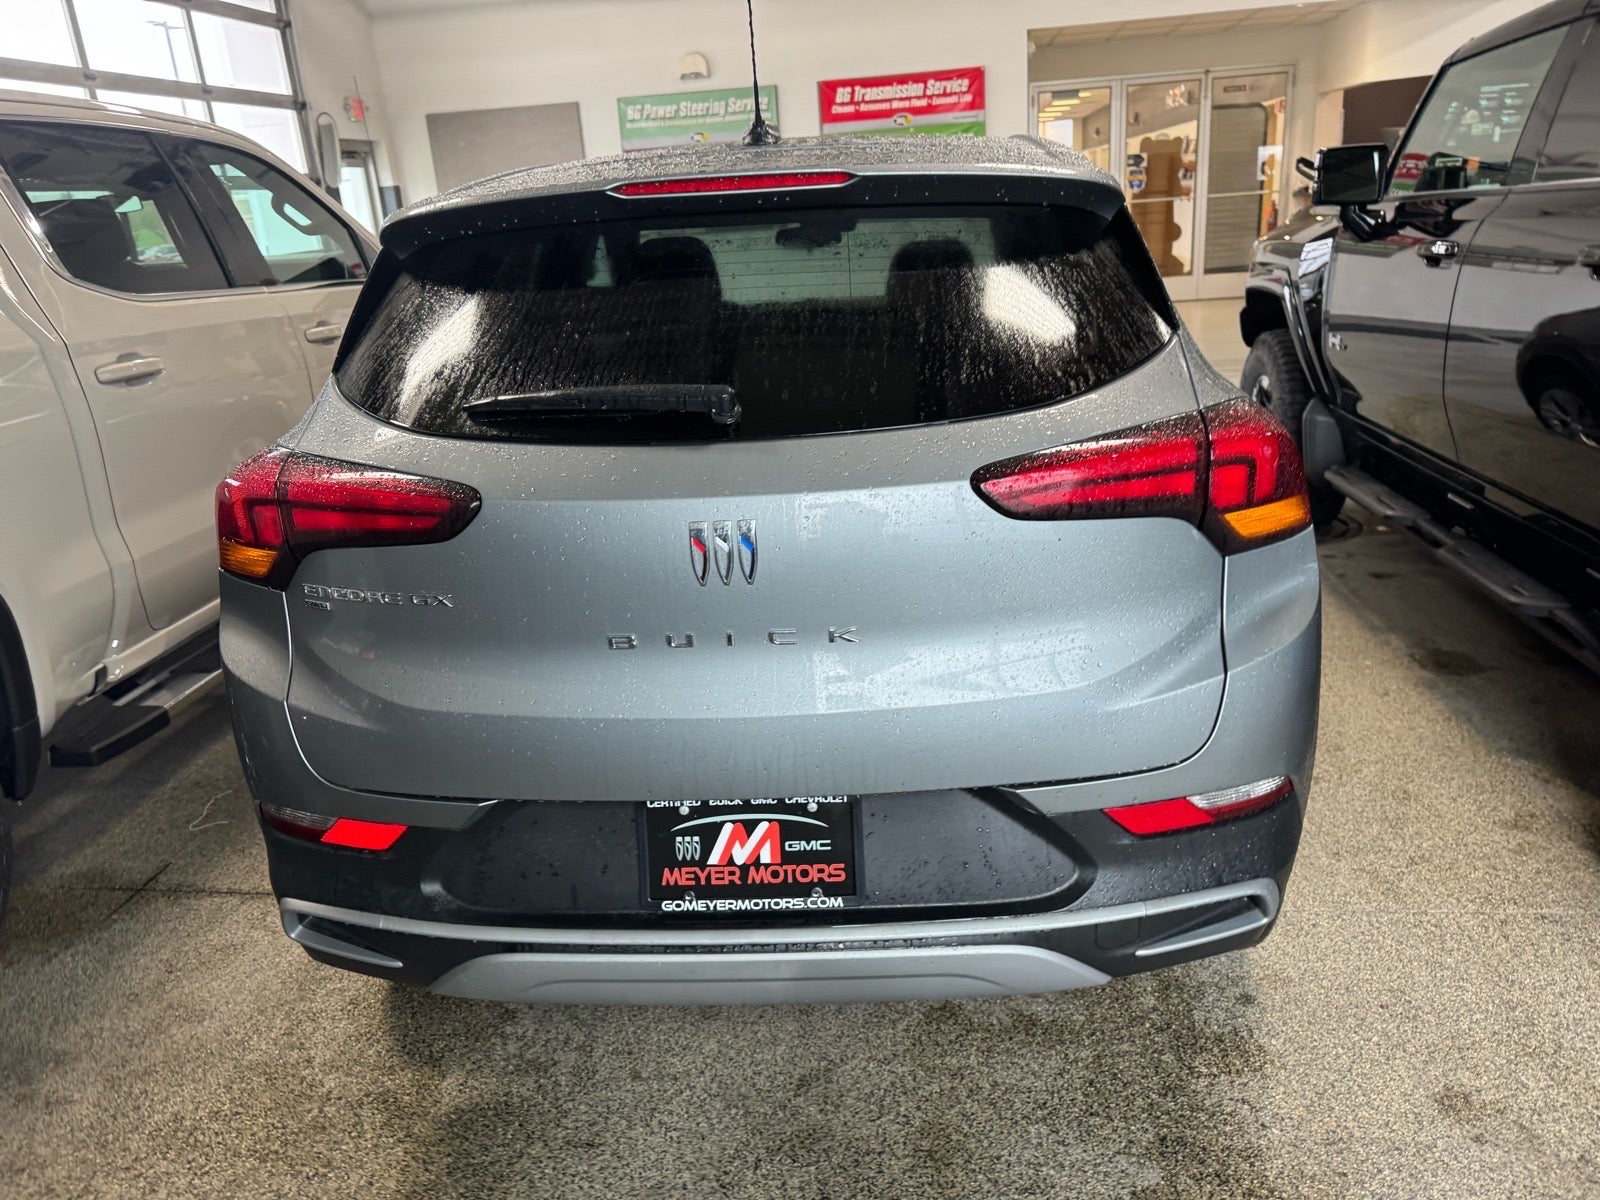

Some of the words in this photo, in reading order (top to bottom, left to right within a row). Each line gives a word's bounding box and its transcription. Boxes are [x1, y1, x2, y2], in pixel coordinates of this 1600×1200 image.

[854, 82, 925, 102] Transmission
[926, 77, 970, 95] Service
[643, 102, 678, 119] Power
[679, 99, 726, 117] Steering
[728, 96, 769, 112] Servce
[302, 583, 402, 605] ENCORE
[409, 593, 454, 608] GX
[607, 625, 861, 651] BUICK
[784, 839, 832, 851] GMC
[661, 865, 742, 886] MEYER
[747, 863, 847, 884] MOTORS
[661, 896, 844, 912] GOMEYERMOTORS.COM
